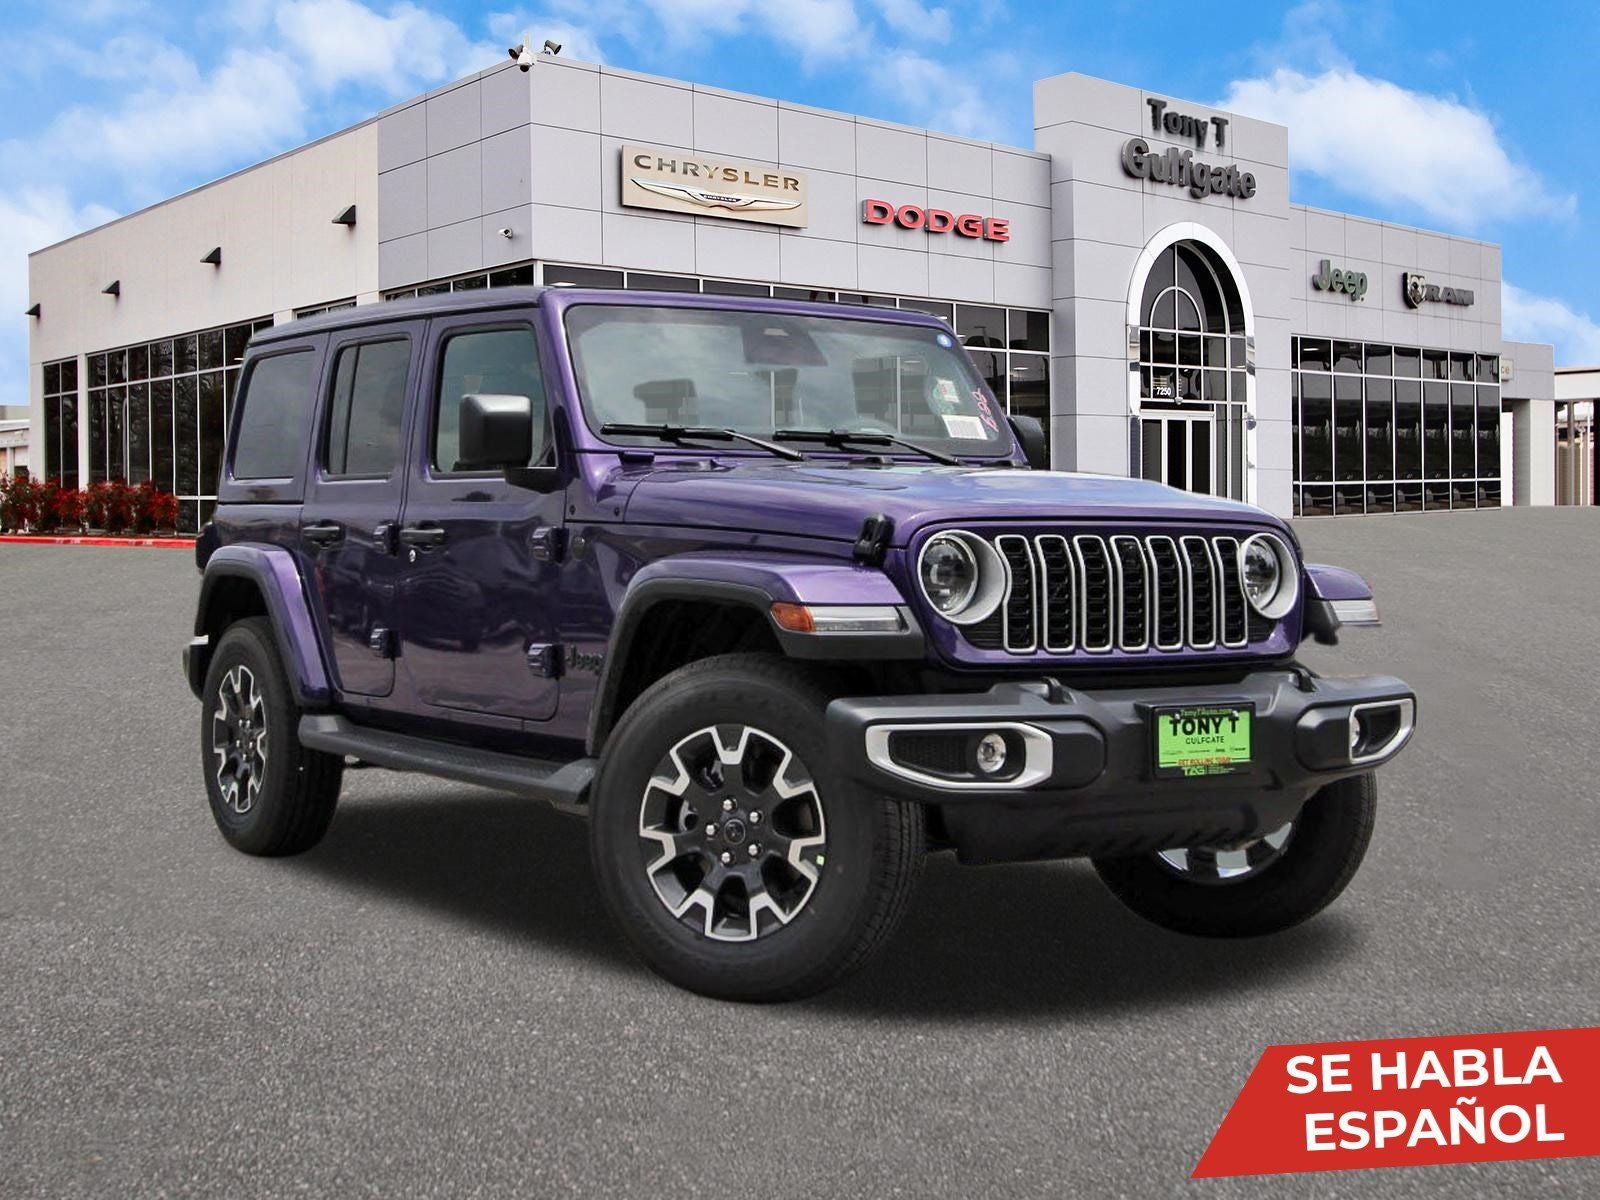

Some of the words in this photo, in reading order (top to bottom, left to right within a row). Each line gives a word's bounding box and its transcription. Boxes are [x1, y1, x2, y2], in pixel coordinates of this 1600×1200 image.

[1147, 98, 1208, 148] Tony
[1210, 117, 1229, 147] T
[633, 154, 800, 191] CHRYSLER
[1121, 138, 1257, 199] Gulfgate
[863, 199, 1010, 242] DODGE
[1312, 260, 1367, 302] Jeep
[1425, 284, 1475, 307] RAM
[1156, 386, 1172, 397] 7250
[1169, 717, 1224, 736] TONY
[1228, 715, 1239, 733] T
